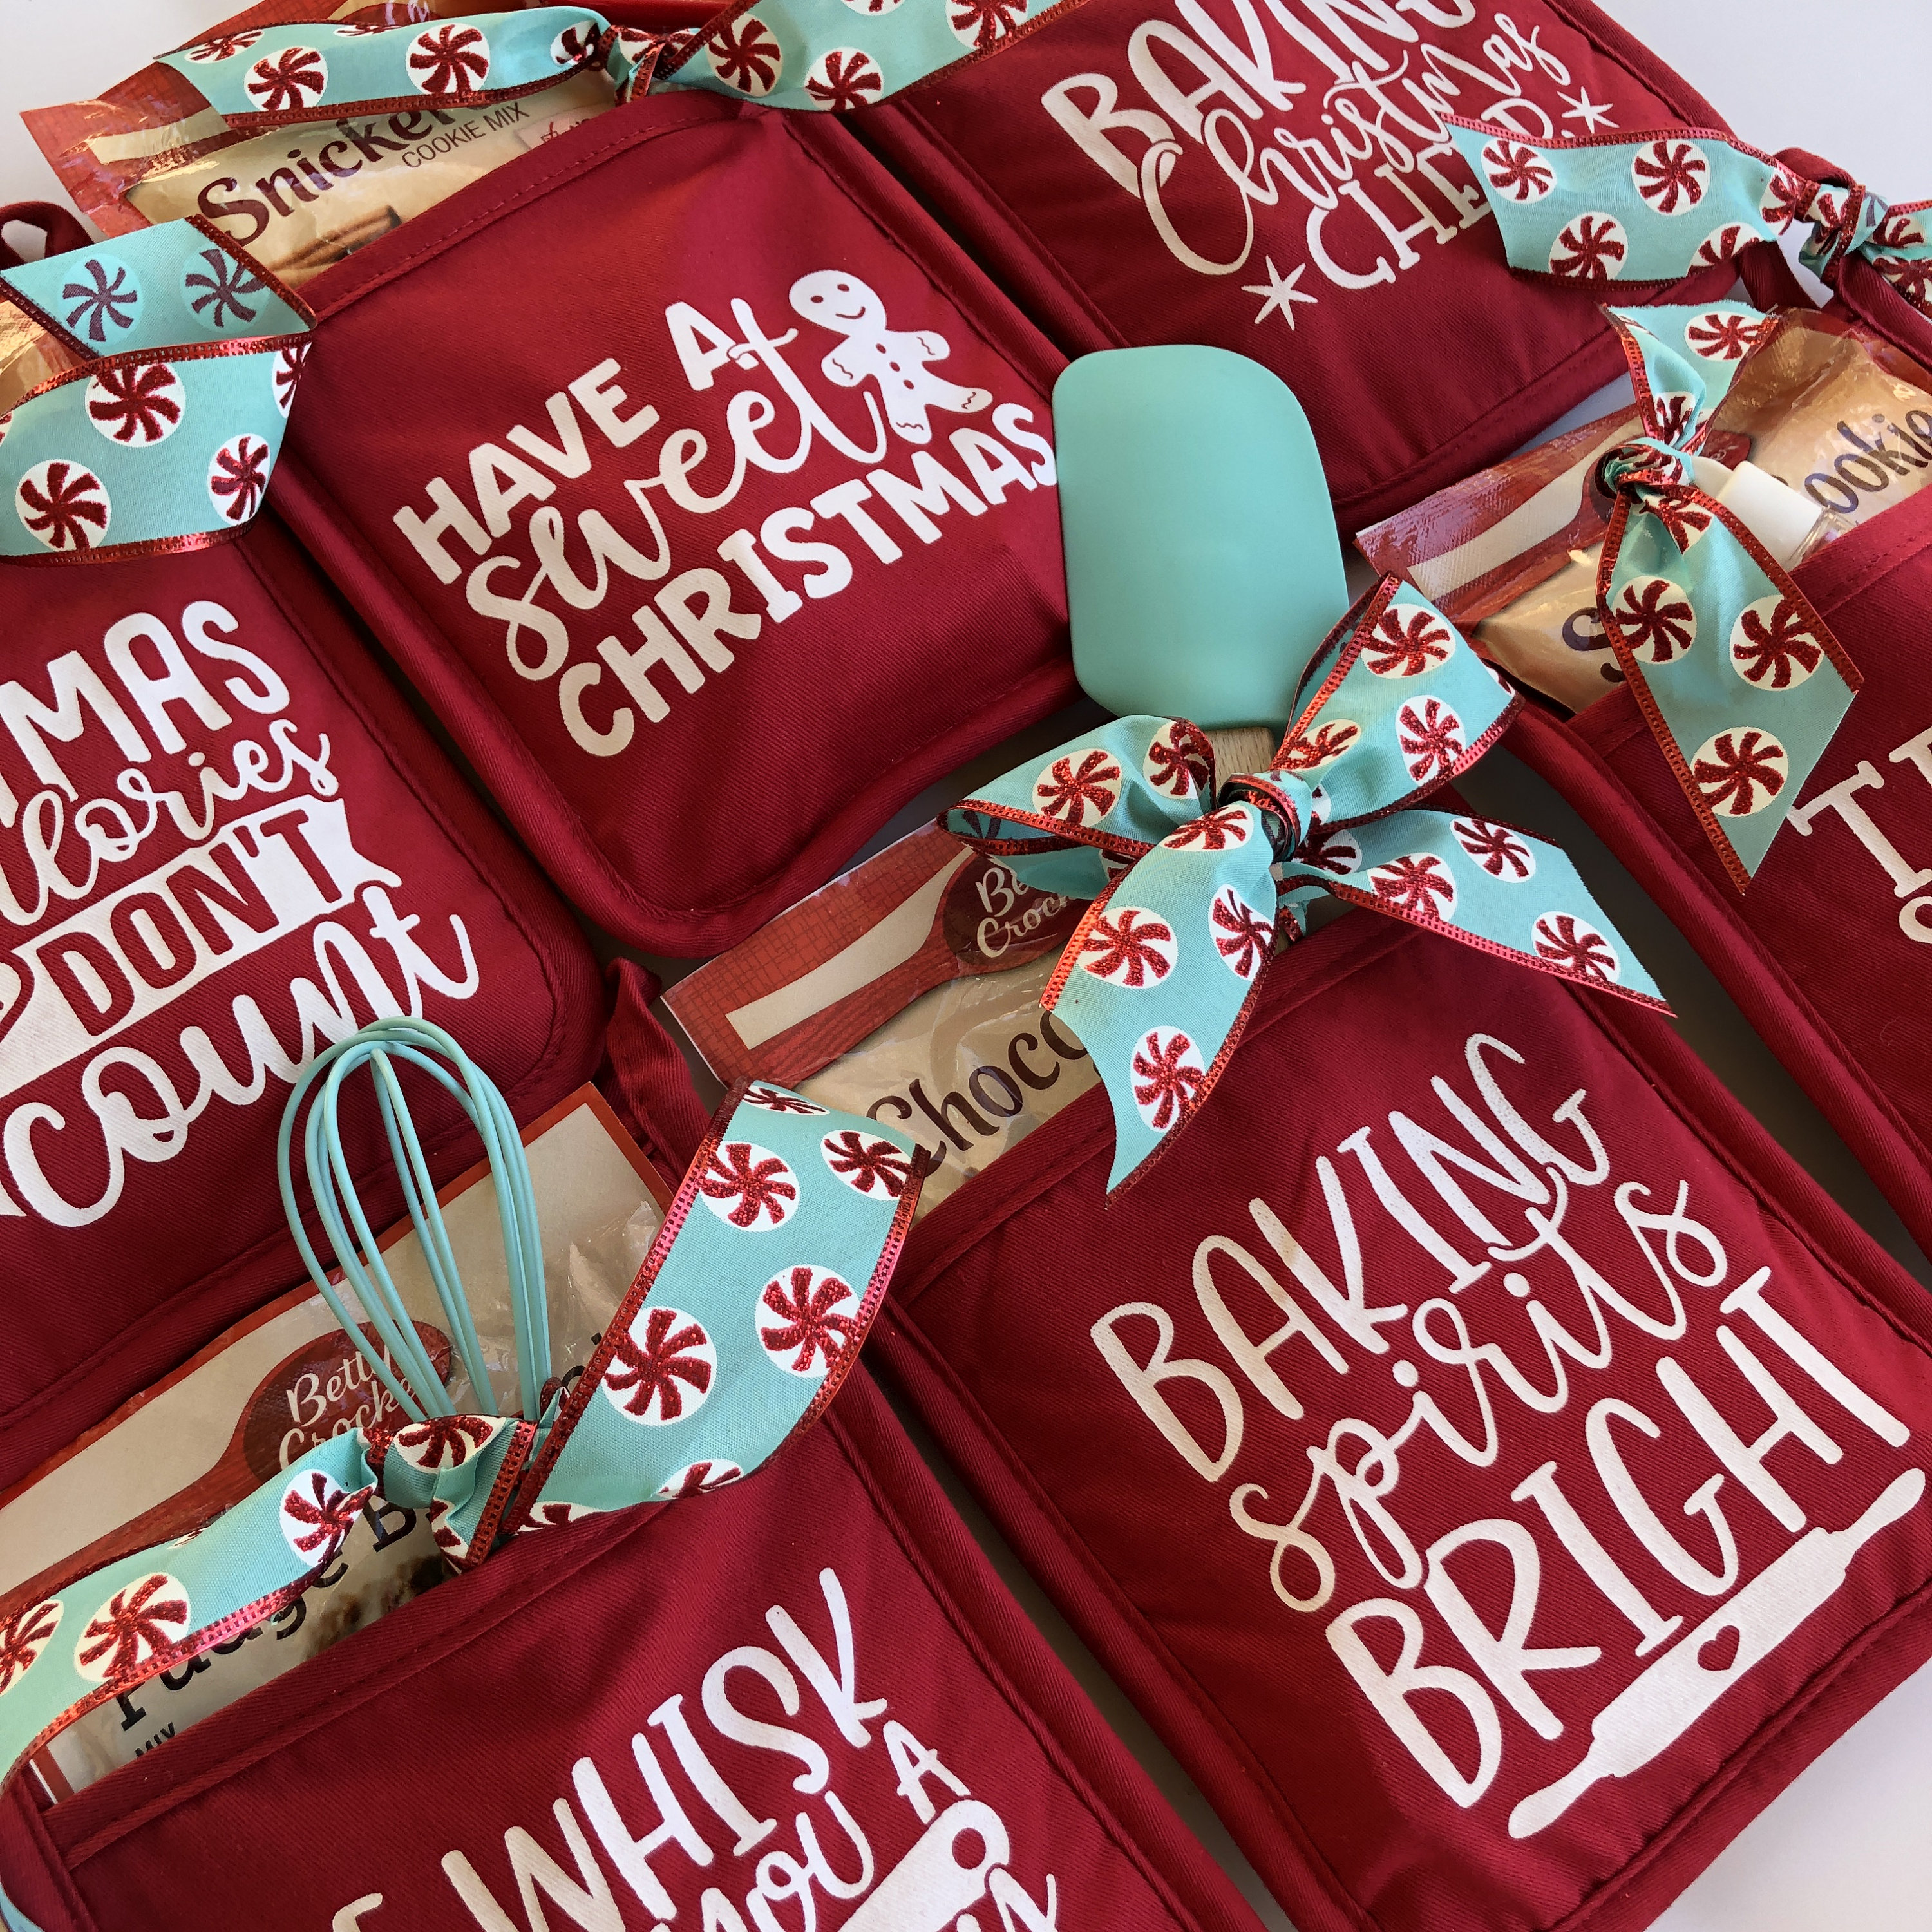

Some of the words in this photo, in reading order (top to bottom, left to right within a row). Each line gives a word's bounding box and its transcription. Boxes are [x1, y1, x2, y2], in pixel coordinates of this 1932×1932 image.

[402, 121, 486, 167] COOKIE
[483, 102, 530, 131] MIX
[1041, 0, 1476, 199] BAKIN
[1141, 13, 1571, 275] Christmas
[393, 359, 659, 584] HAVE
[665, 302, 759, 391] A
[466, 298, 887, 680] sweet
[1790, 410, 1932, 514] ookie
[0, 600, 290, 828] MAS
[559, 403, 1057, 756] CHRISTMAS
[0, 719, 339, 925] lories
[37, 809, 343, 1036] DON'T
[5, 886, 478, 1227] count
[1090, 1034, 1609, 1482] BAKING
[1229, 1167, 1727, 1612] spirits
[1326, 1267, 1911, 1808] BRIGHT
[440, 1568, 887, 1932] WHISK
[882, 1720, 971, 1824] A
